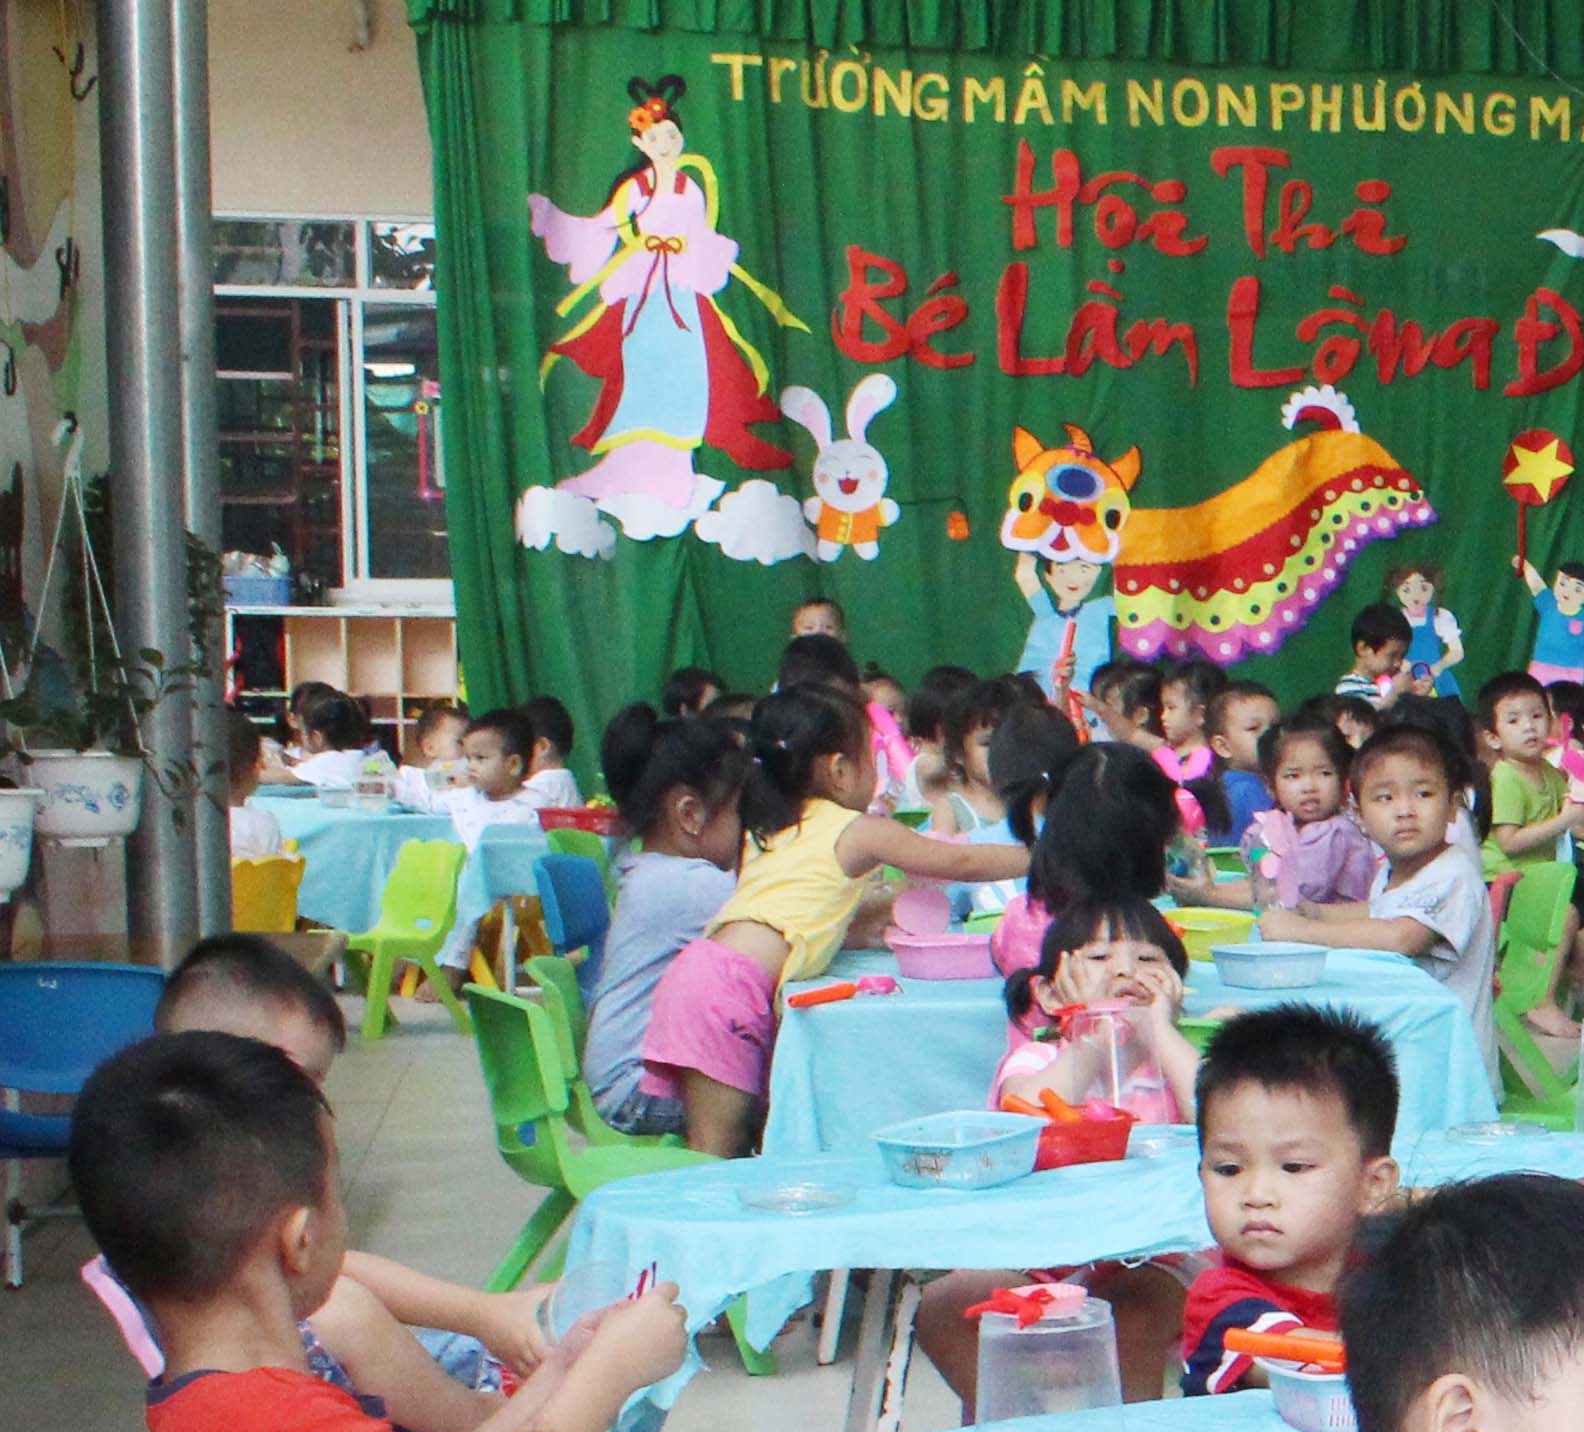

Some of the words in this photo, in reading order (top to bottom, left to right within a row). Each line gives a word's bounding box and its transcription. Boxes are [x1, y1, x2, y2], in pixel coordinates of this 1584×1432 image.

[1126, 77, 1258, 128] NON
[1002, 138, 1209, 273] Hội
[1210, 145, 1407, 260] Thi
[831, 245, 976, 369] Bé
[995, 261, 1198, 389] Làm
